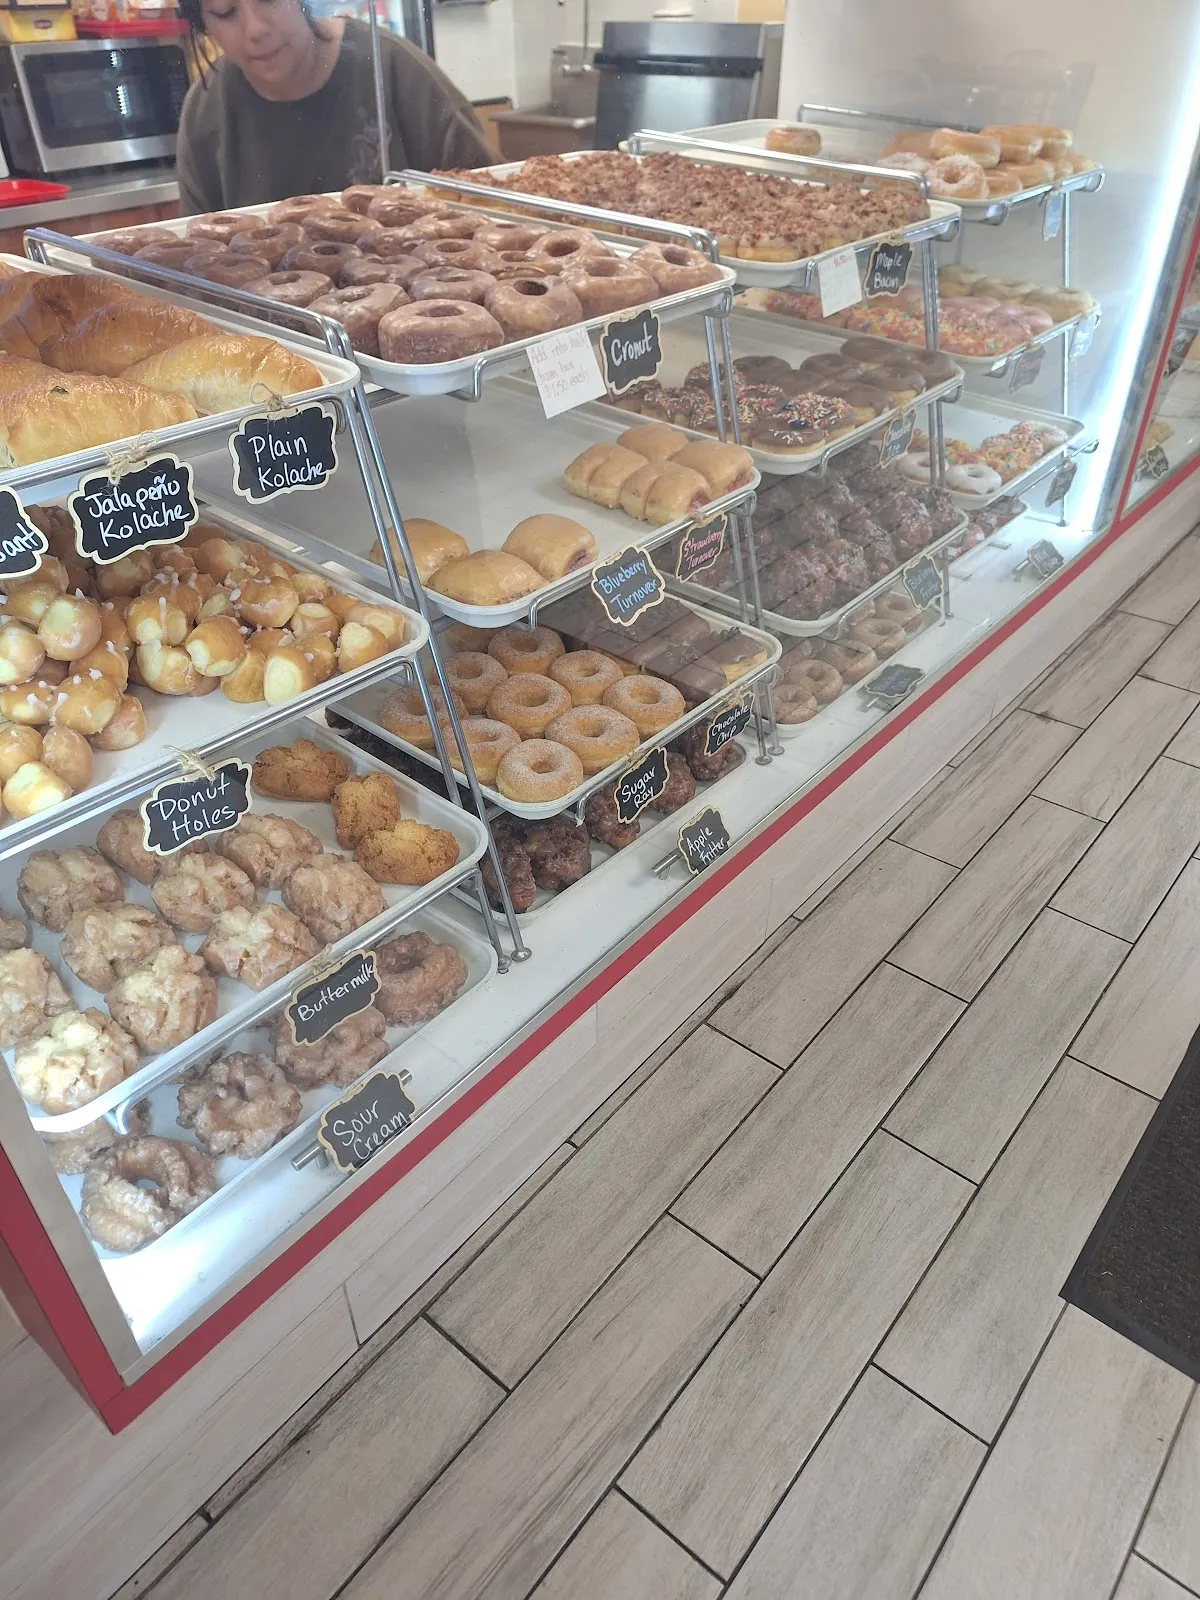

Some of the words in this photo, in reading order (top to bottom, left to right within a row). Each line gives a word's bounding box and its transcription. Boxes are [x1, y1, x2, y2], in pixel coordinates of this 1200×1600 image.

[875, 252, 903, 271] Maple
[610, 321, 653, 367] Cronut
[247, 431, 308, 463] Plain
[258, 457, 327, 492] Kolache
[84, 473, 181, 518] Jalapeño
[99, 502, 190, 547] Kolache
[599, 559, 648, 595] Blueberry
[610, 579, 657, 613] Turnover
[711, 704, 750, 737] Chocolate
[716, 725, 737, 746] Chip
[151, 772, 231, 821] Donut
[621, 766, 656, 803] Sugar
[171, 805, 236, 842] Holes
[686, 827, 713, 857] Apple
[699, 837, 725, 866] Fritter
[297, 962, 376, 1022] Buttermilk
[333, 1099, 379, 1147] Sour
[353, 1111, 409, 1160] Cream
